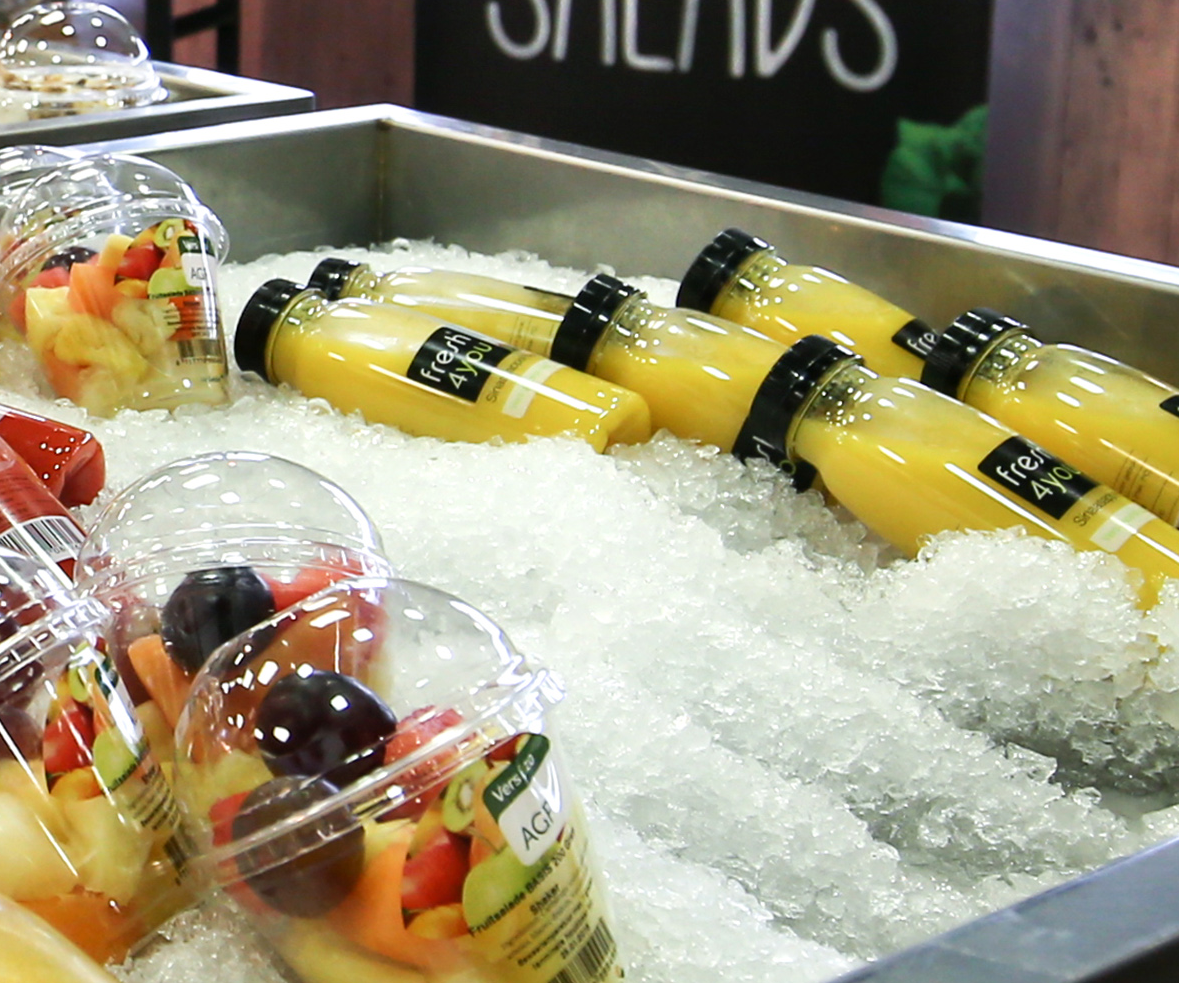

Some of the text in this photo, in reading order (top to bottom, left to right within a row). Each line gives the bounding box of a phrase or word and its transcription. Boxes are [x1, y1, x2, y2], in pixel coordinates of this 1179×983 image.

[421, 333, 472, 383] fresh
[449, 342, 493, 390] 4you
[491, 772, 523, 802] Vers
